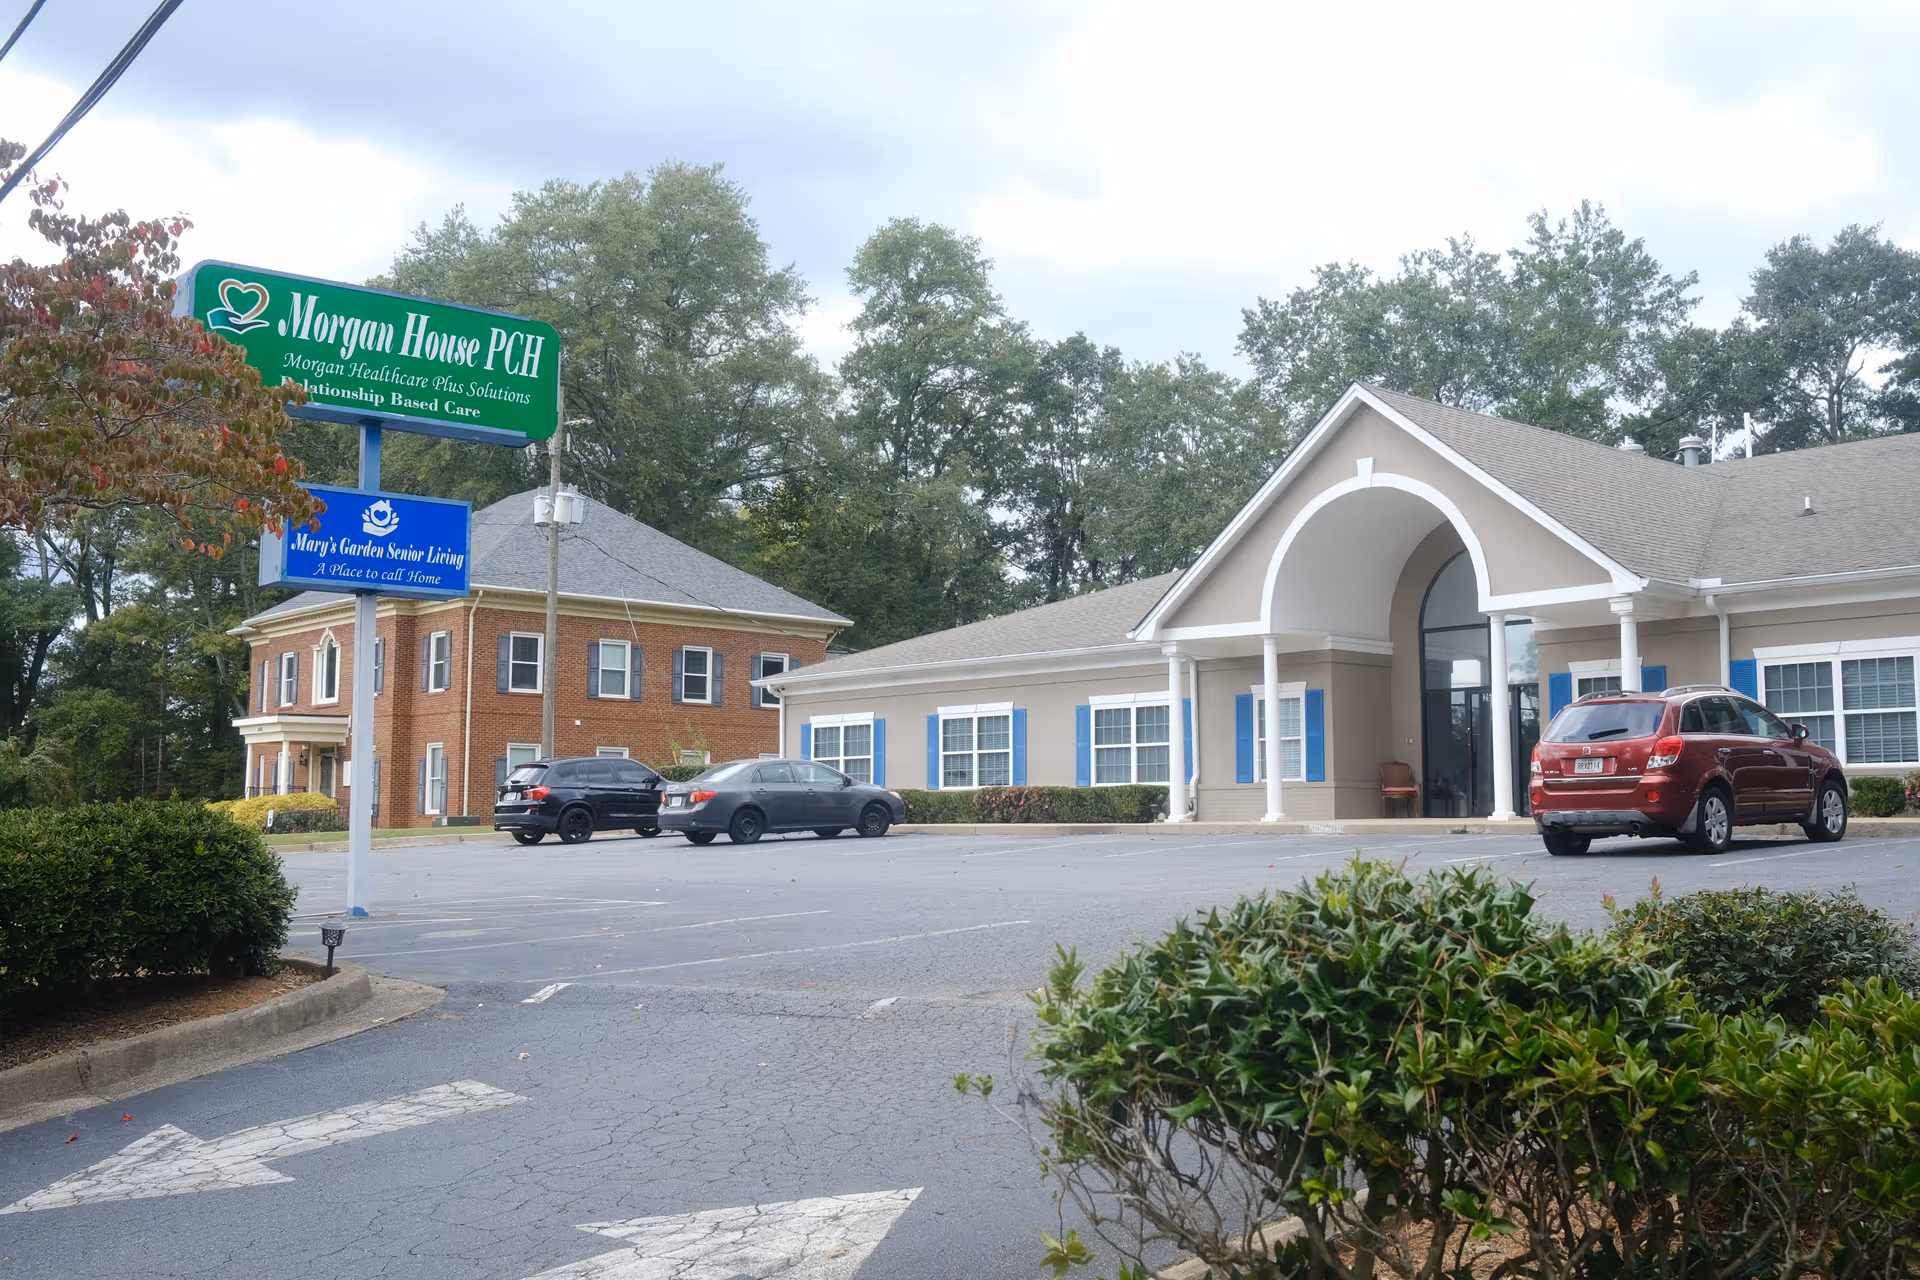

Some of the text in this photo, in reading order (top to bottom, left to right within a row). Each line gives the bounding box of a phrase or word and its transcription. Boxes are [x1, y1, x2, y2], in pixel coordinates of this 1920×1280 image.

[278, 292, 545, 378] Morgan House PCH
[283, 353, 531, 404] Morgan Healthcare Plus Solutions
[391, 392, 438, 412] Based
[444, 401, 481, 418] Care
[291, 533, 464, 570] Mary's Garden Senior Living
[313, 563, 441, 585] A Place to call Home
